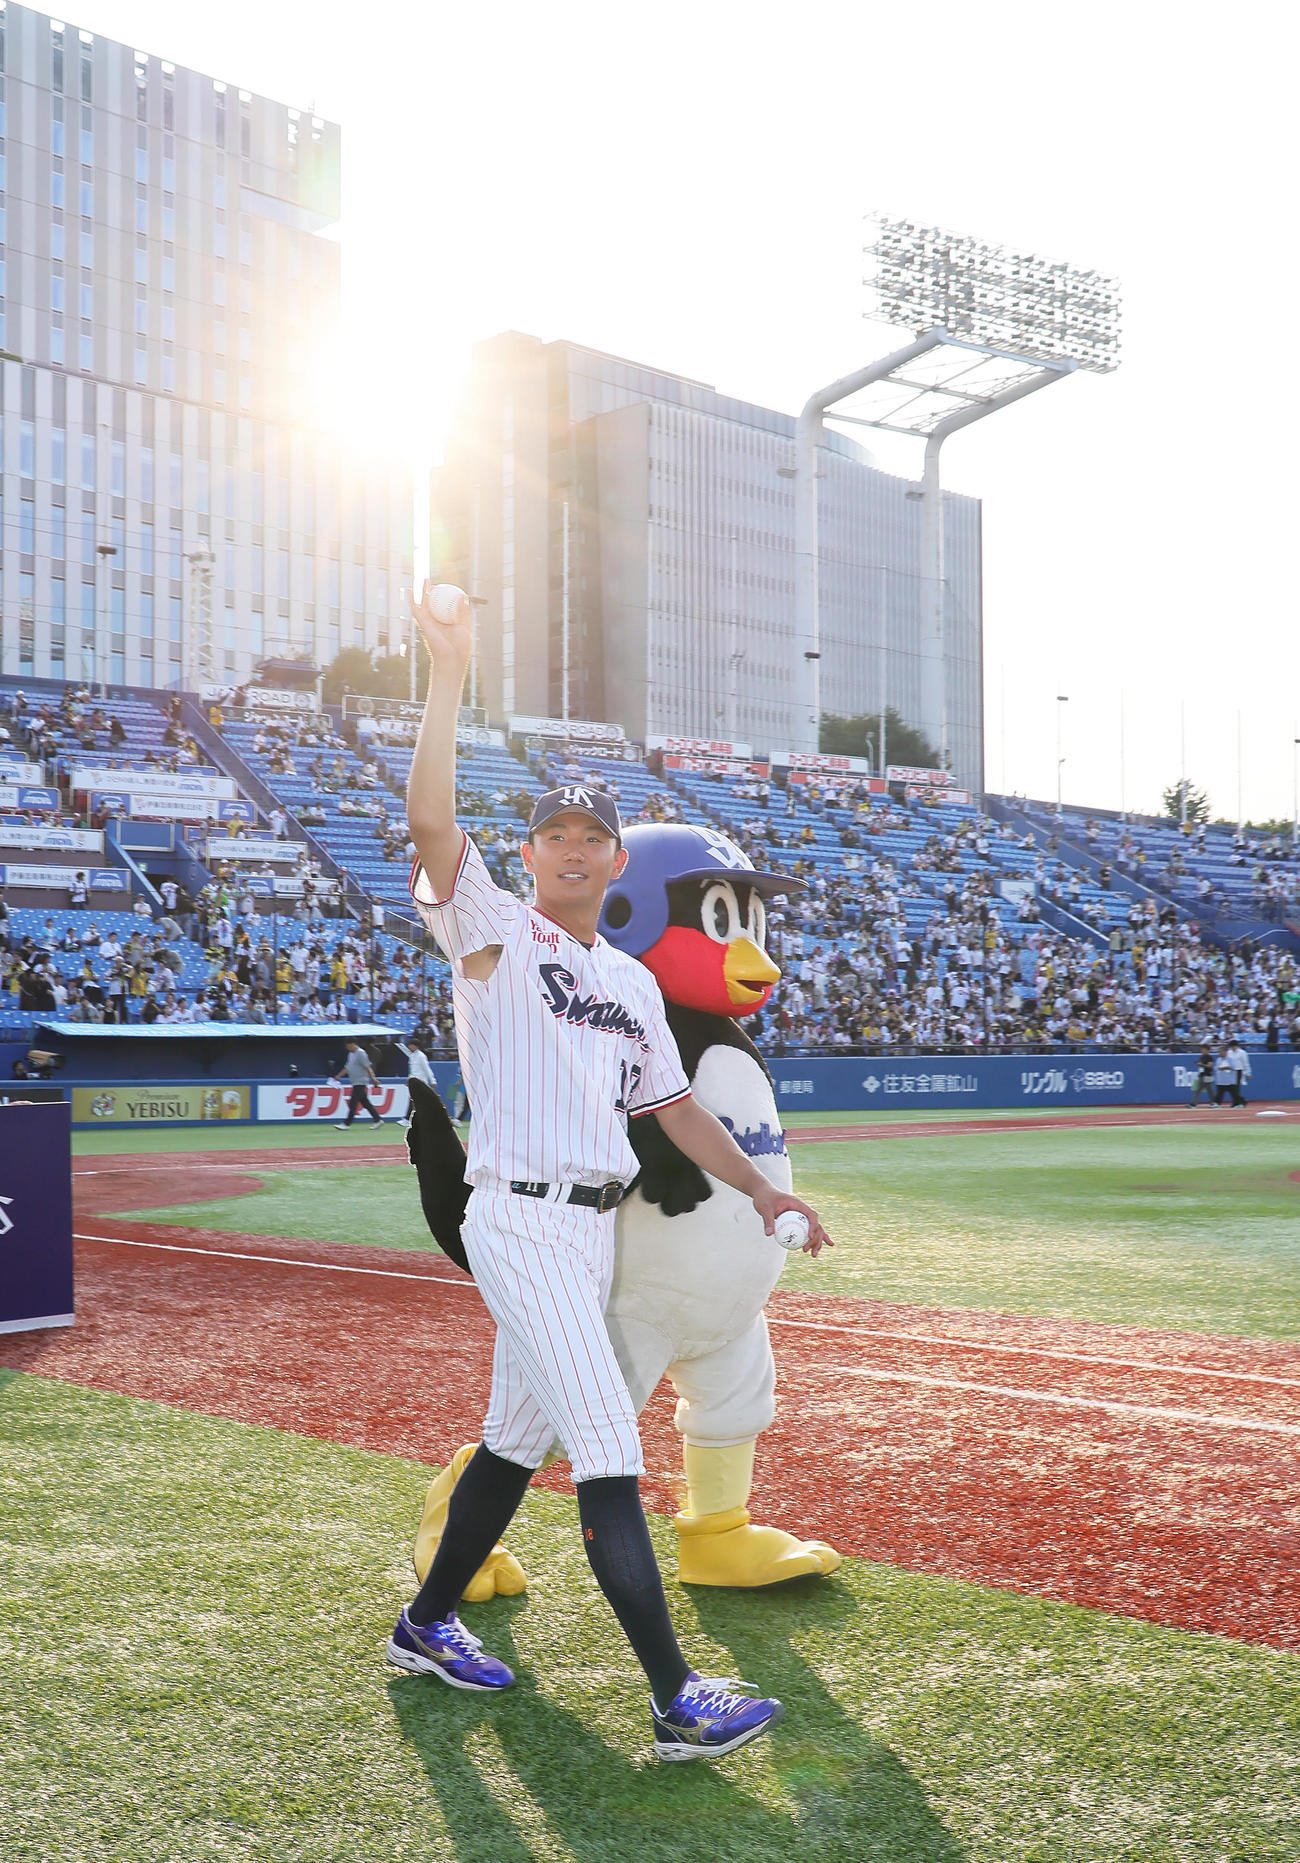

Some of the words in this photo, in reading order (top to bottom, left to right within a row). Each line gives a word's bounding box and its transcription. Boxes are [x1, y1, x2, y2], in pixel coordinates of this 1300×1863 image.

[779, 1080, 815, 1094] 郵便局
[882, 1074, 978, 1094] 住友金属鉱山
[125, 1101, 190, 1118] YEBISU
